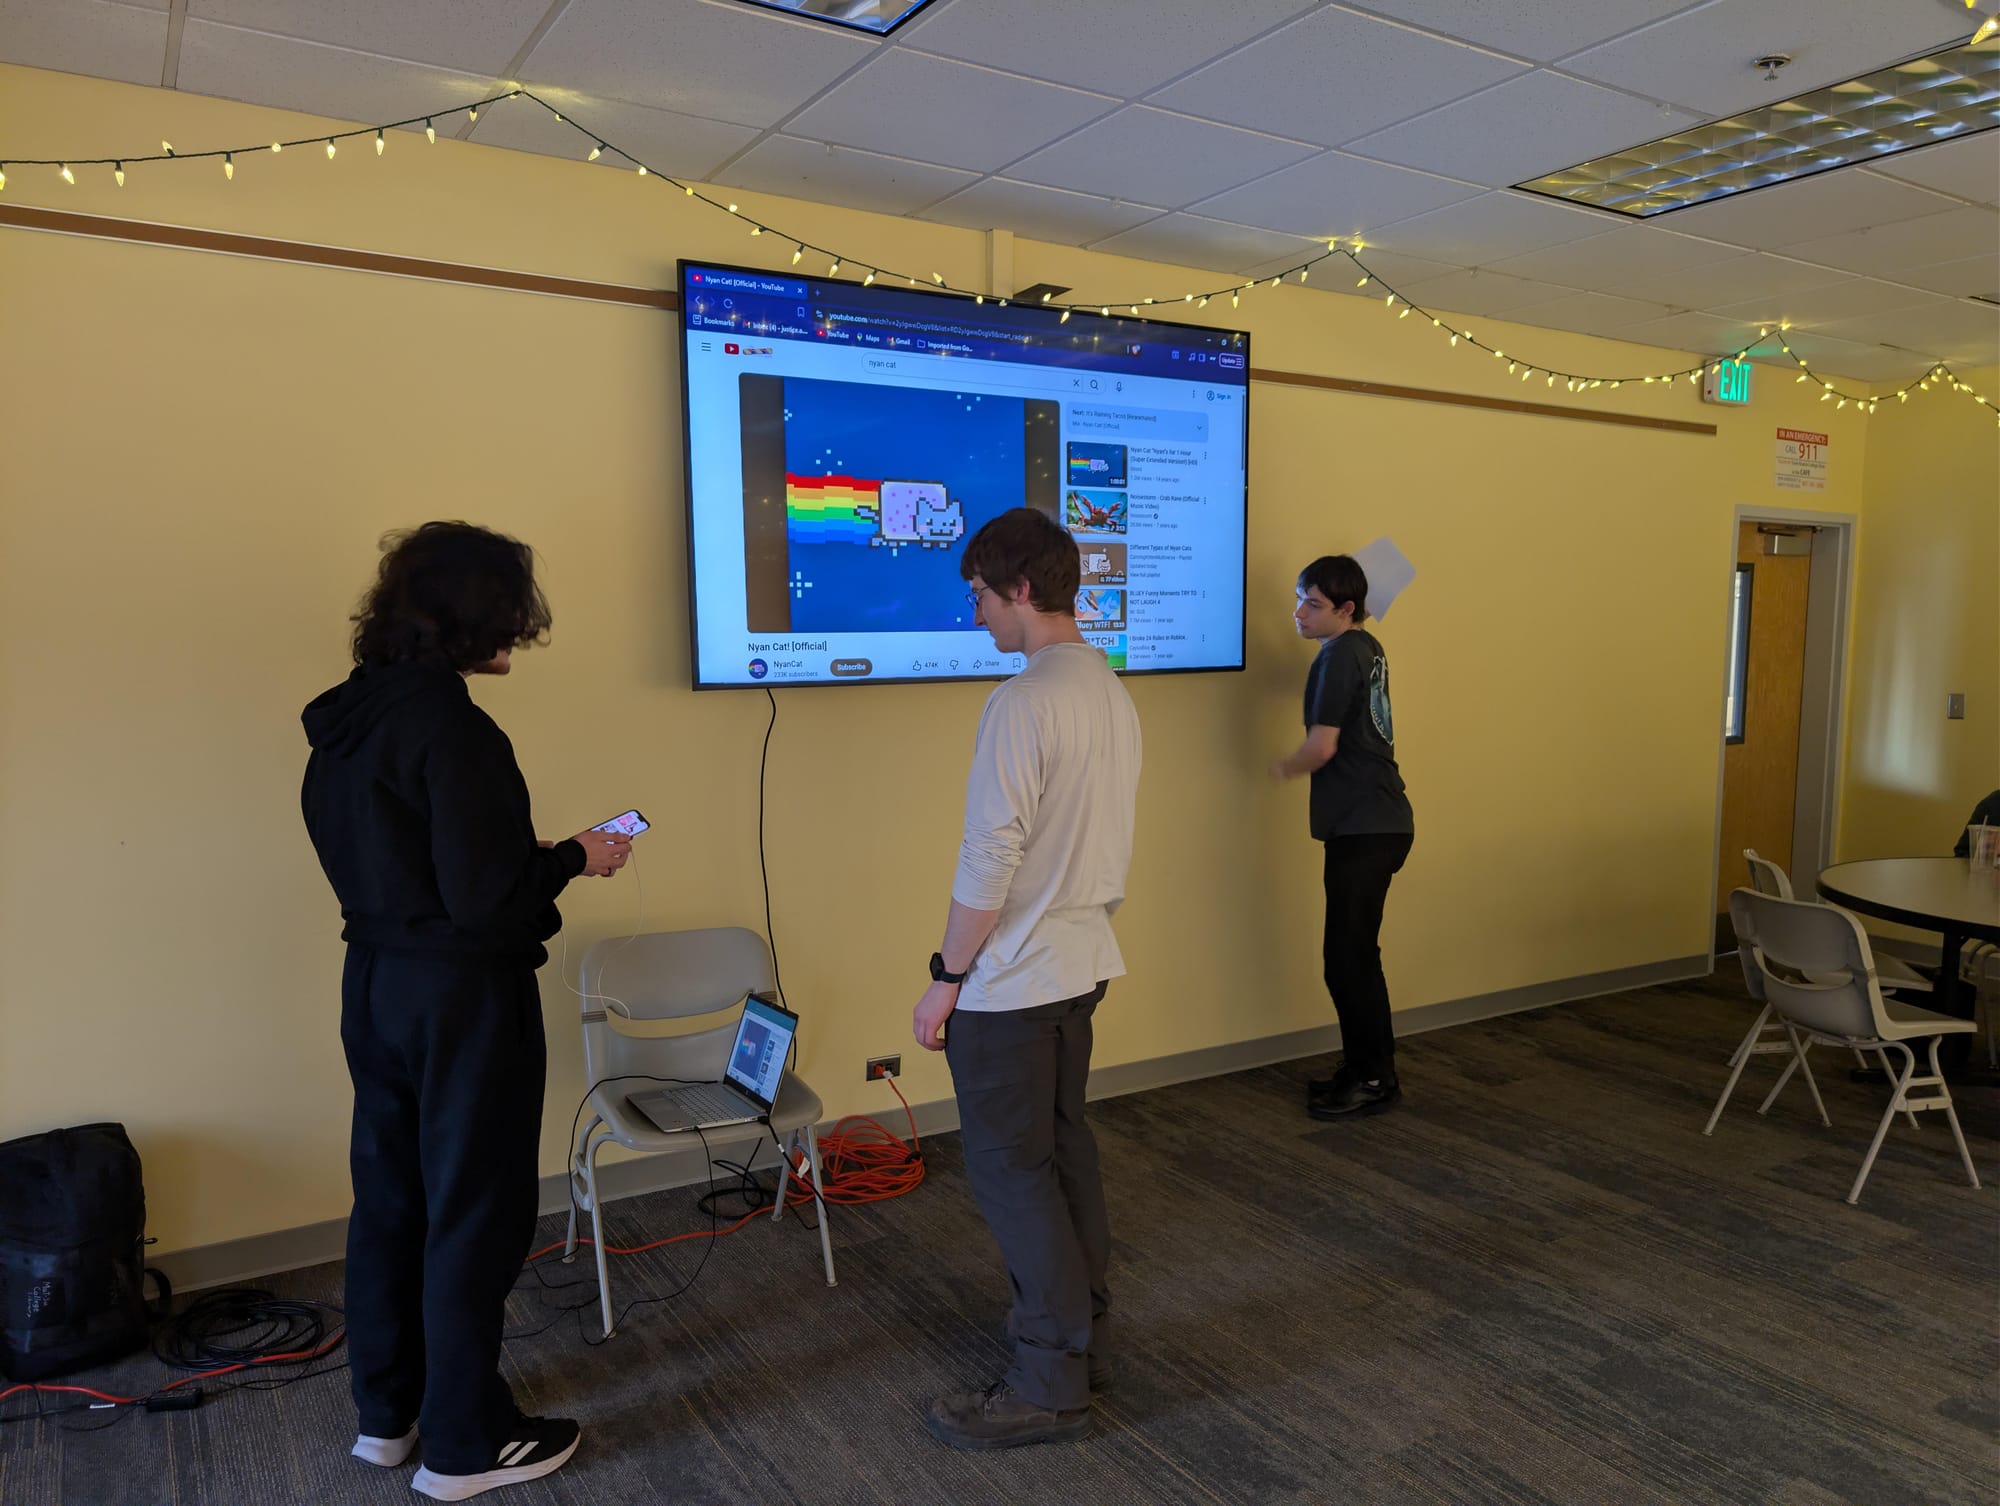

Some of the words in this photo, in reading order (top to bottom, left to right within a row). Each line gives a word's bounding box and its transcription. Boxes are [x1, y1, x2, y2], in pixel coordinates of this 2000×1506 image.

[705, 276, 720, 284] Nyan
[734, 279, 756, 289] [Official]
[761, 283, 784, 292] YouTube
[704, 317, 735, 327] Bookmarks
[866, 334, 880, 342] Maps
[928, 341, 950, 350] Imported
[869, 360, 884, 369] nyan
[1720, 360, 1752, 402] EXIT
[1786, 431, 1794, 439] AN
[1785, 444, 1797, 454] CALL
[1799, 443, 1817, 461] 911
[748, 643, 770, 652] Nyan
[773, 642, 789, 651] Cat!
[792, 640, 827, 652] [Official]
[774, 661, 802, 669] NyanCat
